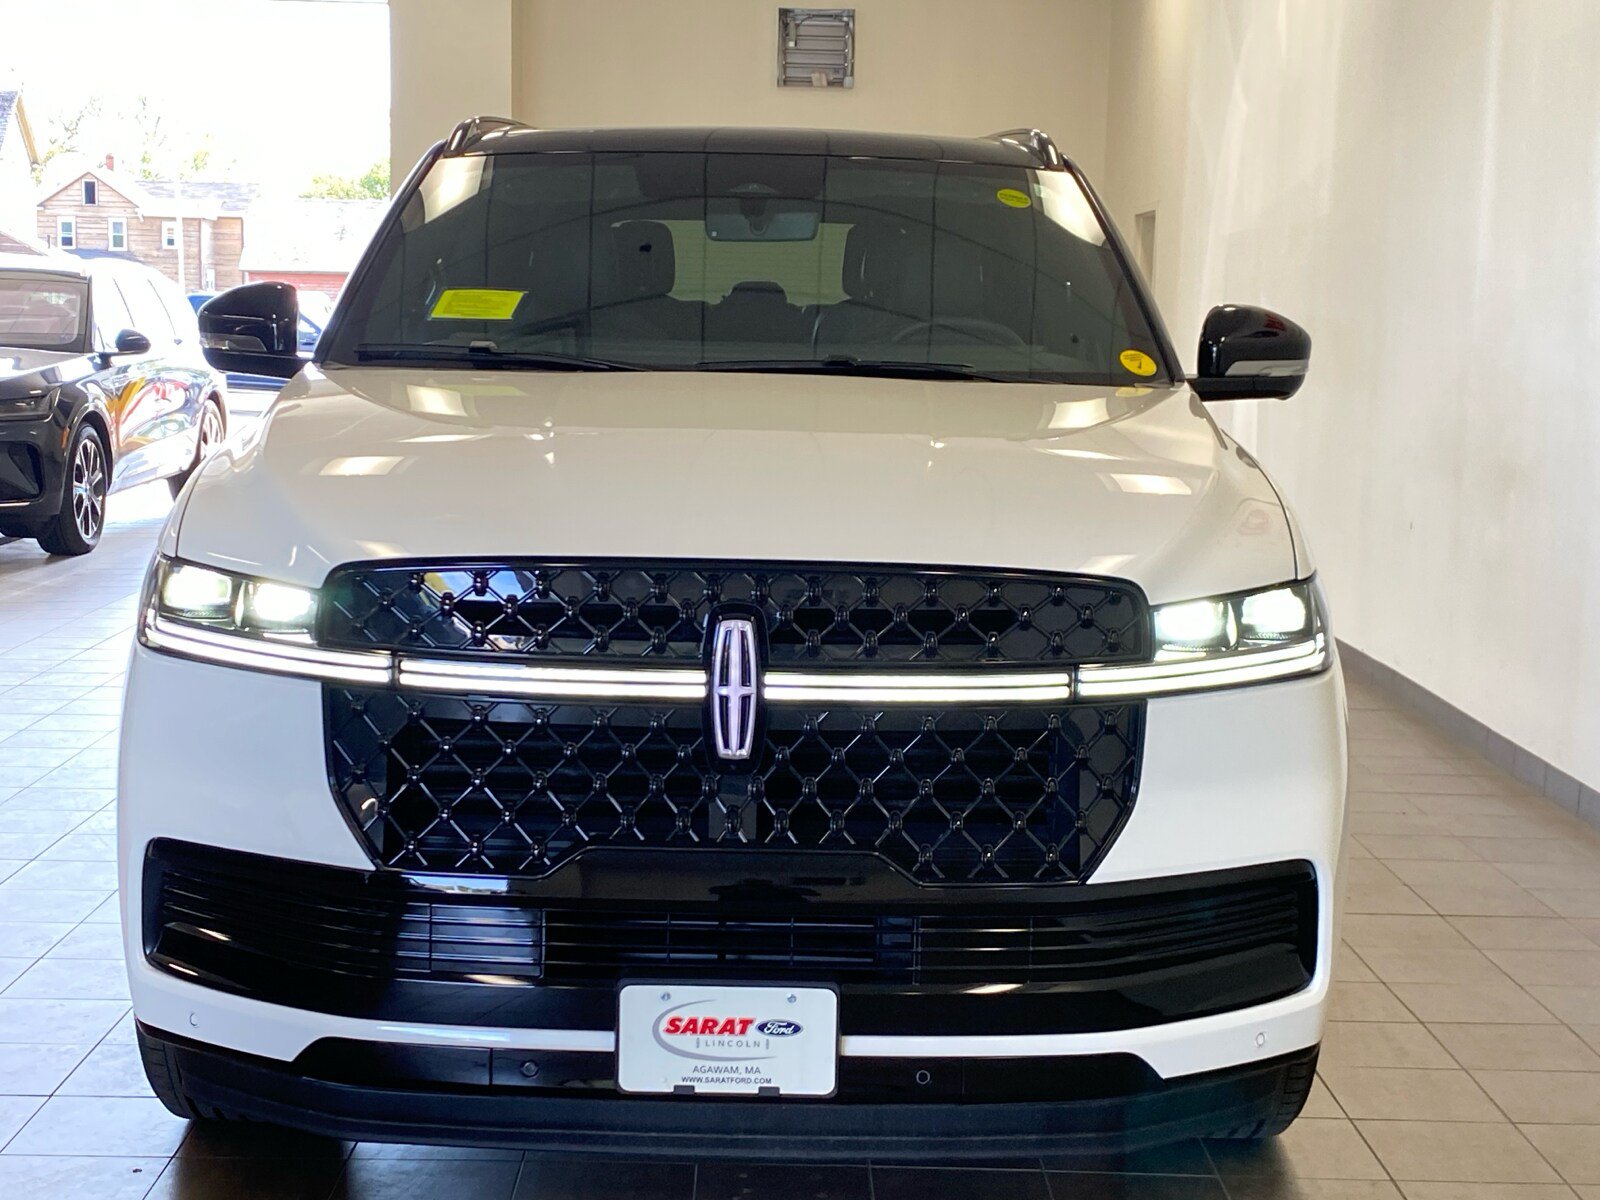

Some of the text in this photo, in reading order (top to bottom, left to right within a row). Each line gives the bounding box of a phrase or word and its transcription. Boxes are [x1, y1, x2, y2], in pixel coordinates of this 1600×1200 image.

[664, 1017, 795, 1036] SARAT Ford
[704, 1039, 761, 1048] LINCOLN
[692, 1065, 761, 1075] AGAWAM, MA
[681, 1076, 772, 1085] WWW.SARATFORD.COM
